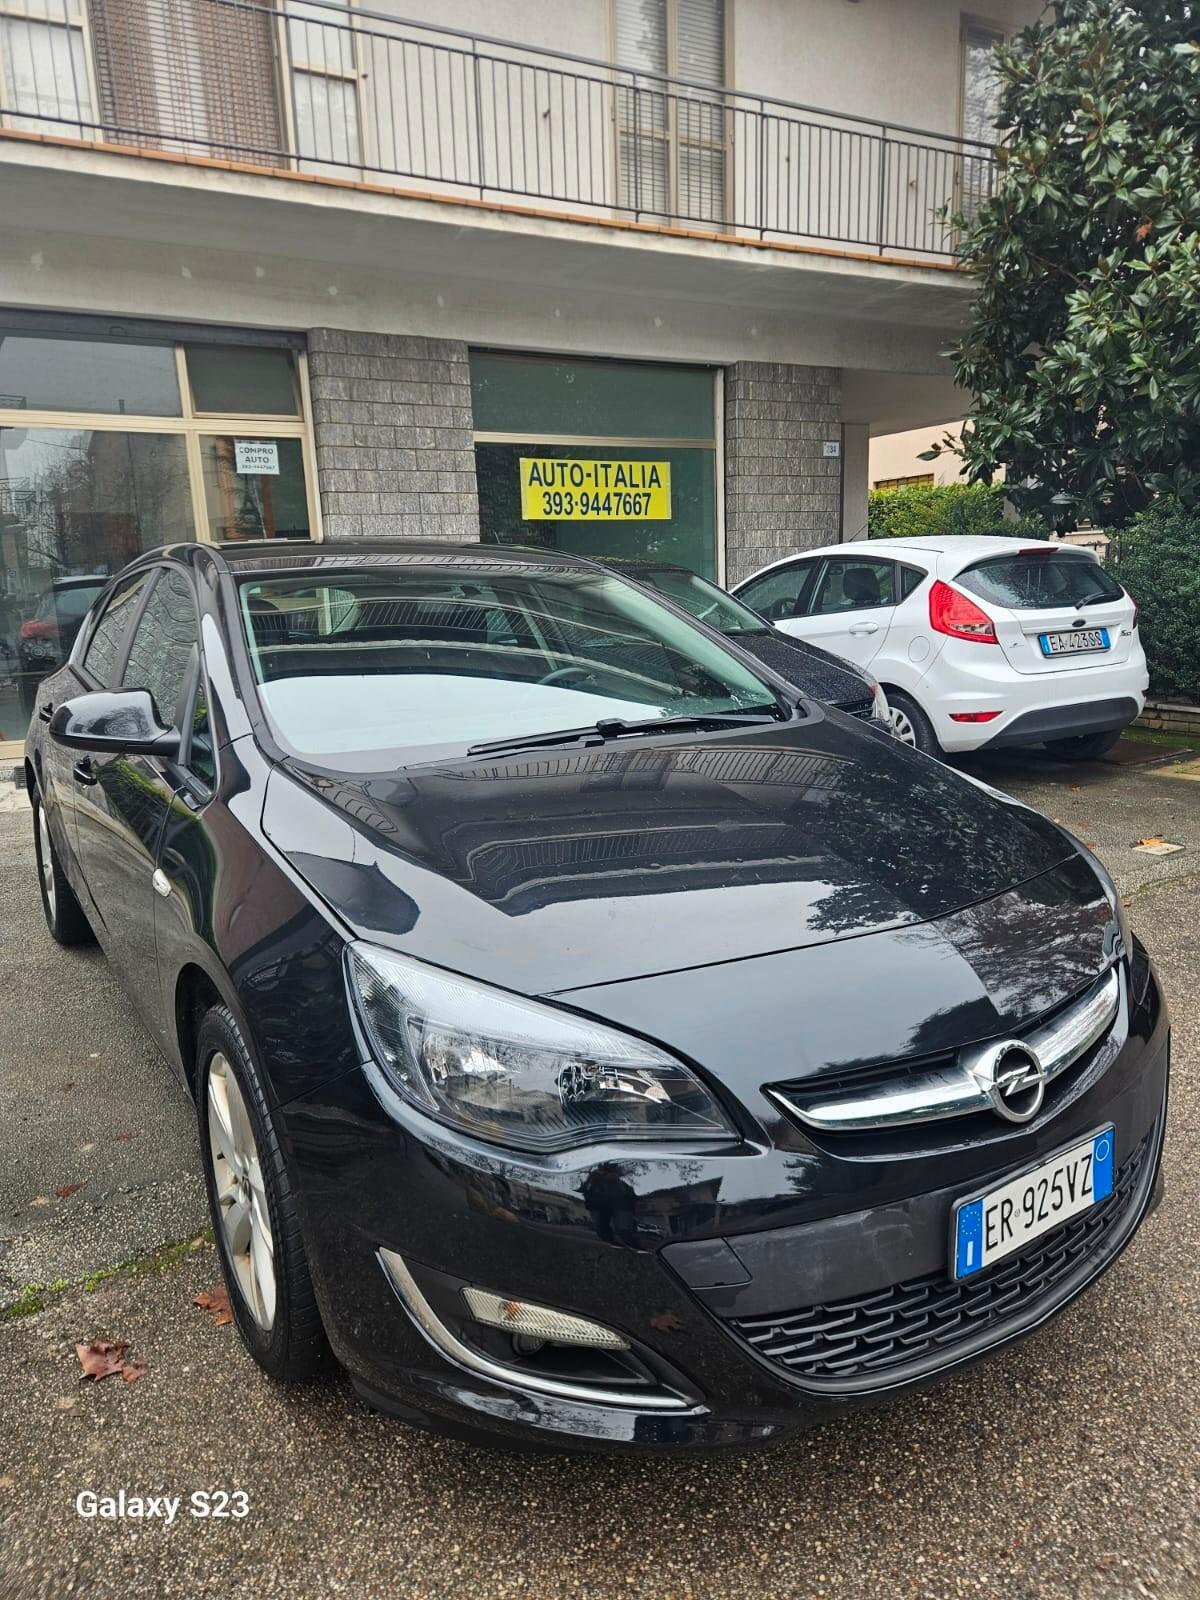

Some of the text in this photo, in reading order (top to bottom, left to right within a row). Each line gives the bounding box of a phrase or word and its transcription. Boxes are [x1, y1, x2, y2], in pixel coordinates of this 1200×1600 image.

[240, 447, 273, 455] COMPRO
[528, 461, 662, 489] AUTO-ITALIA
[542, 491, 652, 516] 393-9447667
[1049, 635, 1066, 651] EA
[1069, 631, 1103, 649] 423SS
[966, 1153, 1093, 1267] I ER 925VZ
